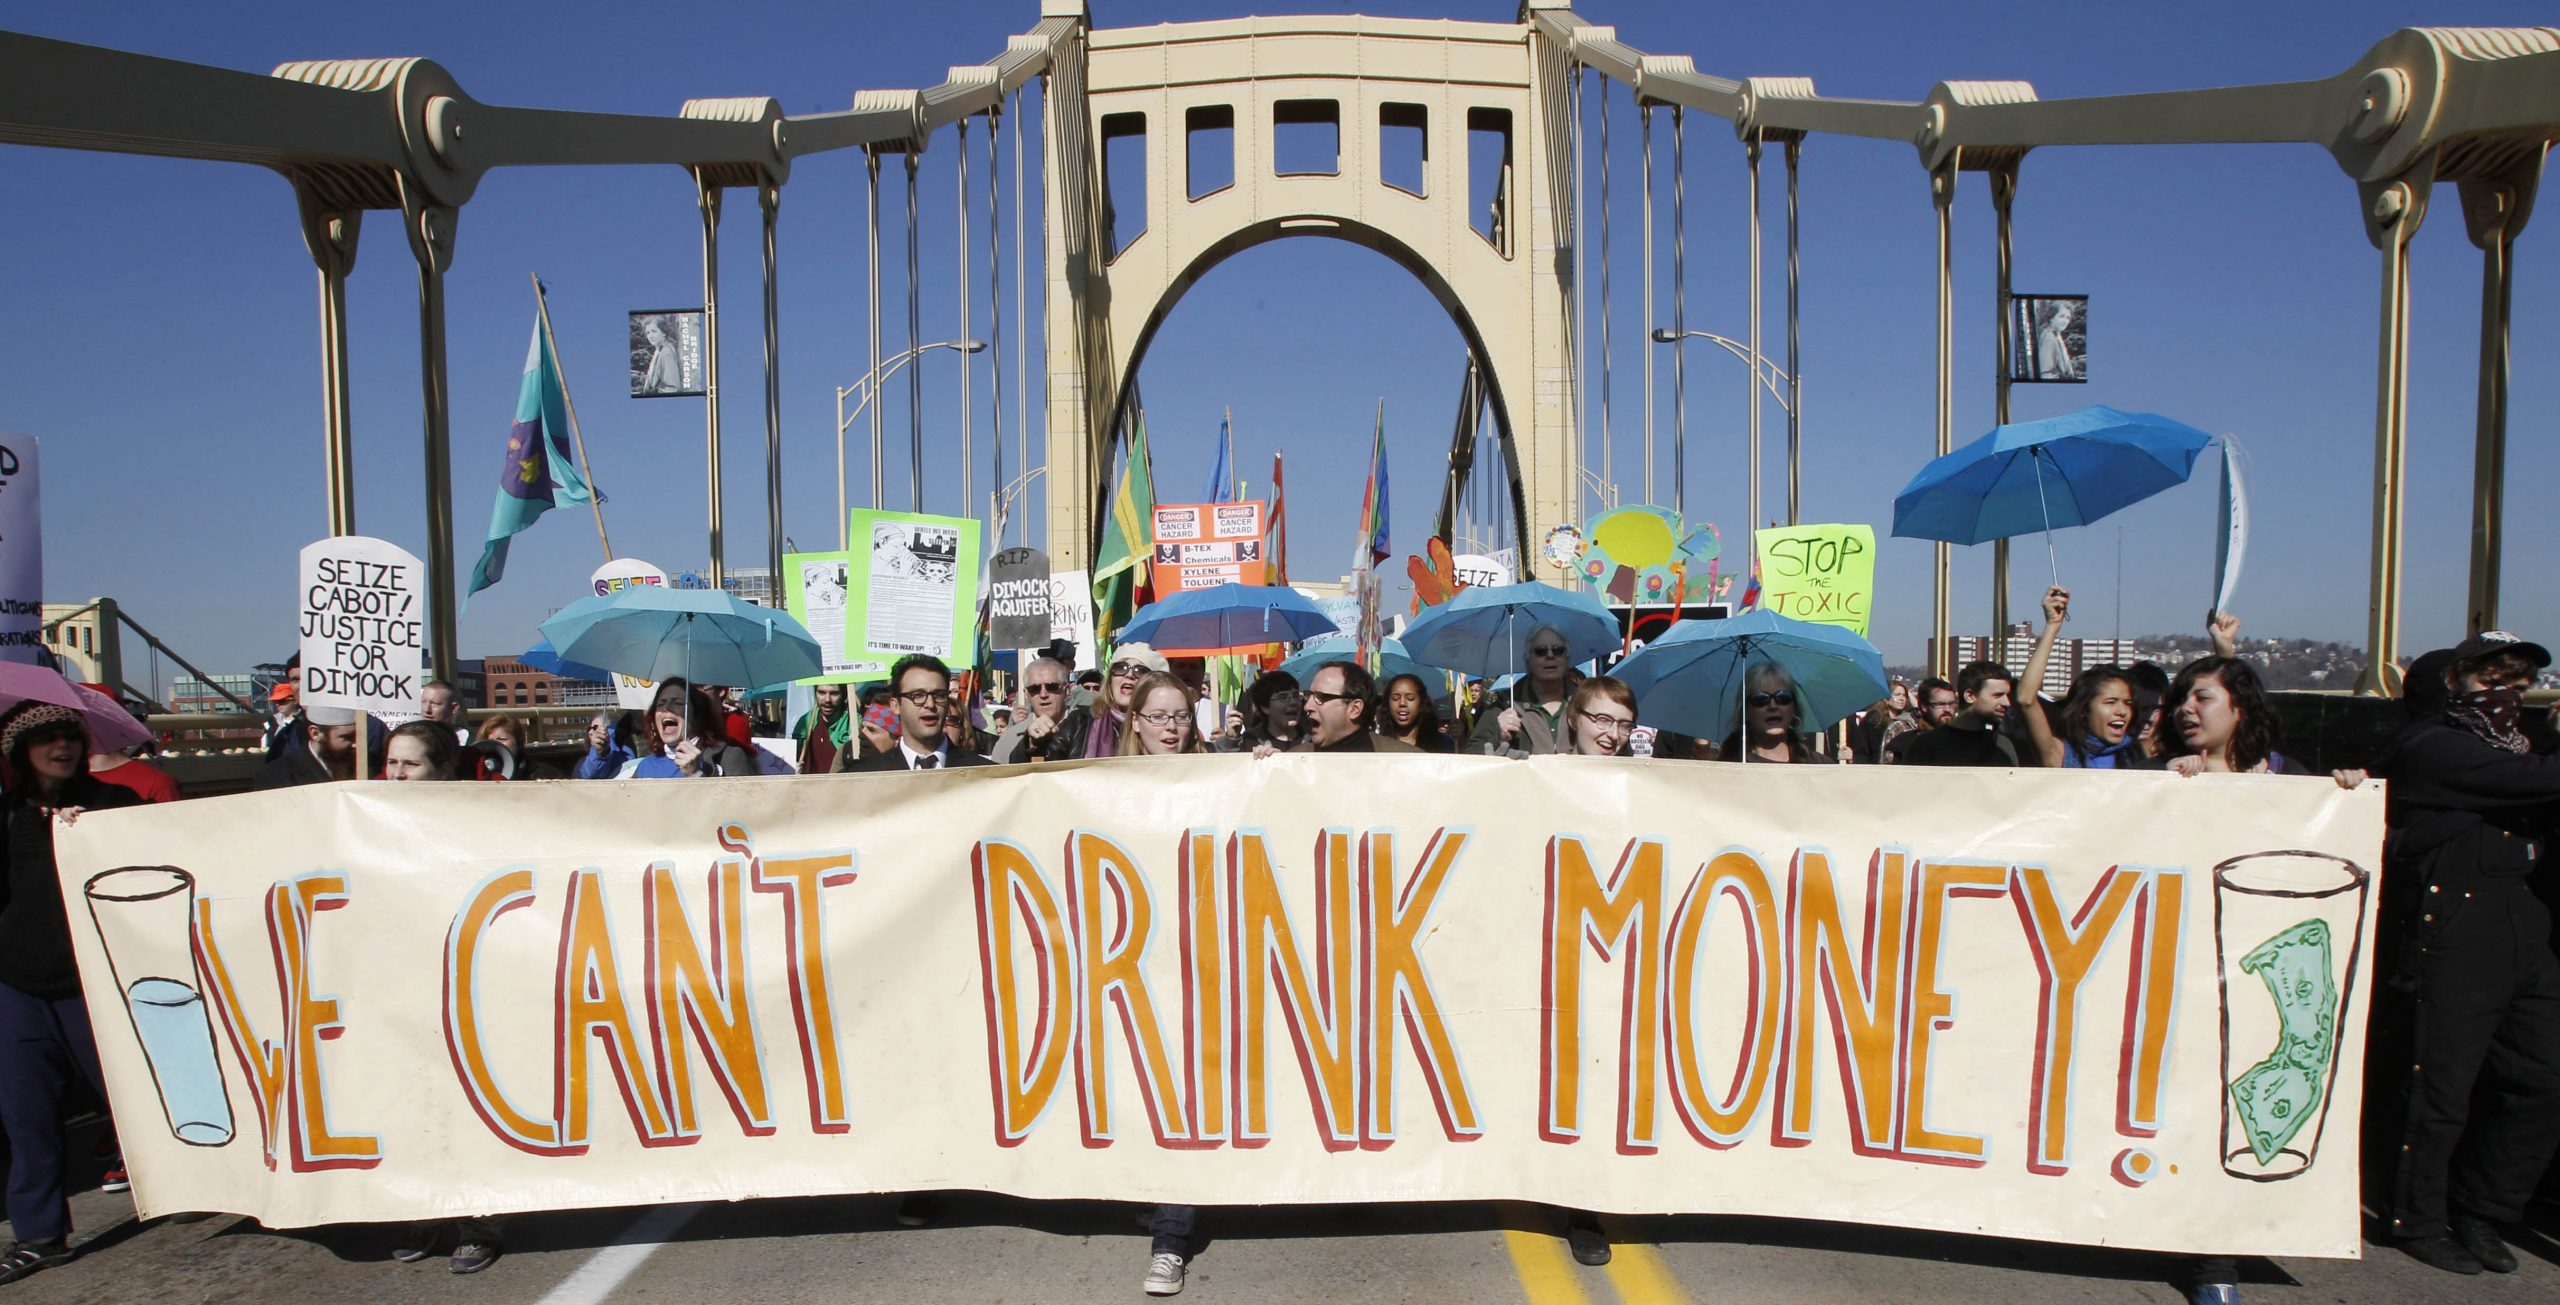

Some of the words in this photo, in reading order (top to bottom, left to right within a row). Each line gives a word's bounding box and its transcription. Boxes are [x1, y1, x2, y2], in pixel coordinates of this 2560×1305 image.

[682, 317, 690, 351] RACHEL
[683, 355, 691, 389] CARSON
[1161, 522, 1193, 531] CANCER
[1161, 530, 1193, 539] HAZARD
[1220, 518, 1252, 527] CANCER
[1221, 526, 1252, 534] HAZARD
[1185, 545, 1212, 553] B-TEX
[1185, 555, 1232, 565] Chemicals
[1770, 536, 1863, 577] STOP
[317, 558, 407, 591] SEIZE
[1184, 567, 1221, 576] XYLENE
[309, 585, 413, 617] CABOT!
[992, 579, 1050, 599] DIMOCK
[991, 597, 1051, 618] AQUIFER
[1773, 591, 1862, 616] TOXIC
[300, 610, 422, 648] JUSTICE
[335, 641, 389, 671] FOR
[308, 667, 413, 700] DIMOCK
[193, 868, 383, 1172] WE
[442, 822, 859, 1158] CAN'T
[970, 826, 1487, 1152] DRINK
[1538, 833, 2189, 1188] MONEY!
